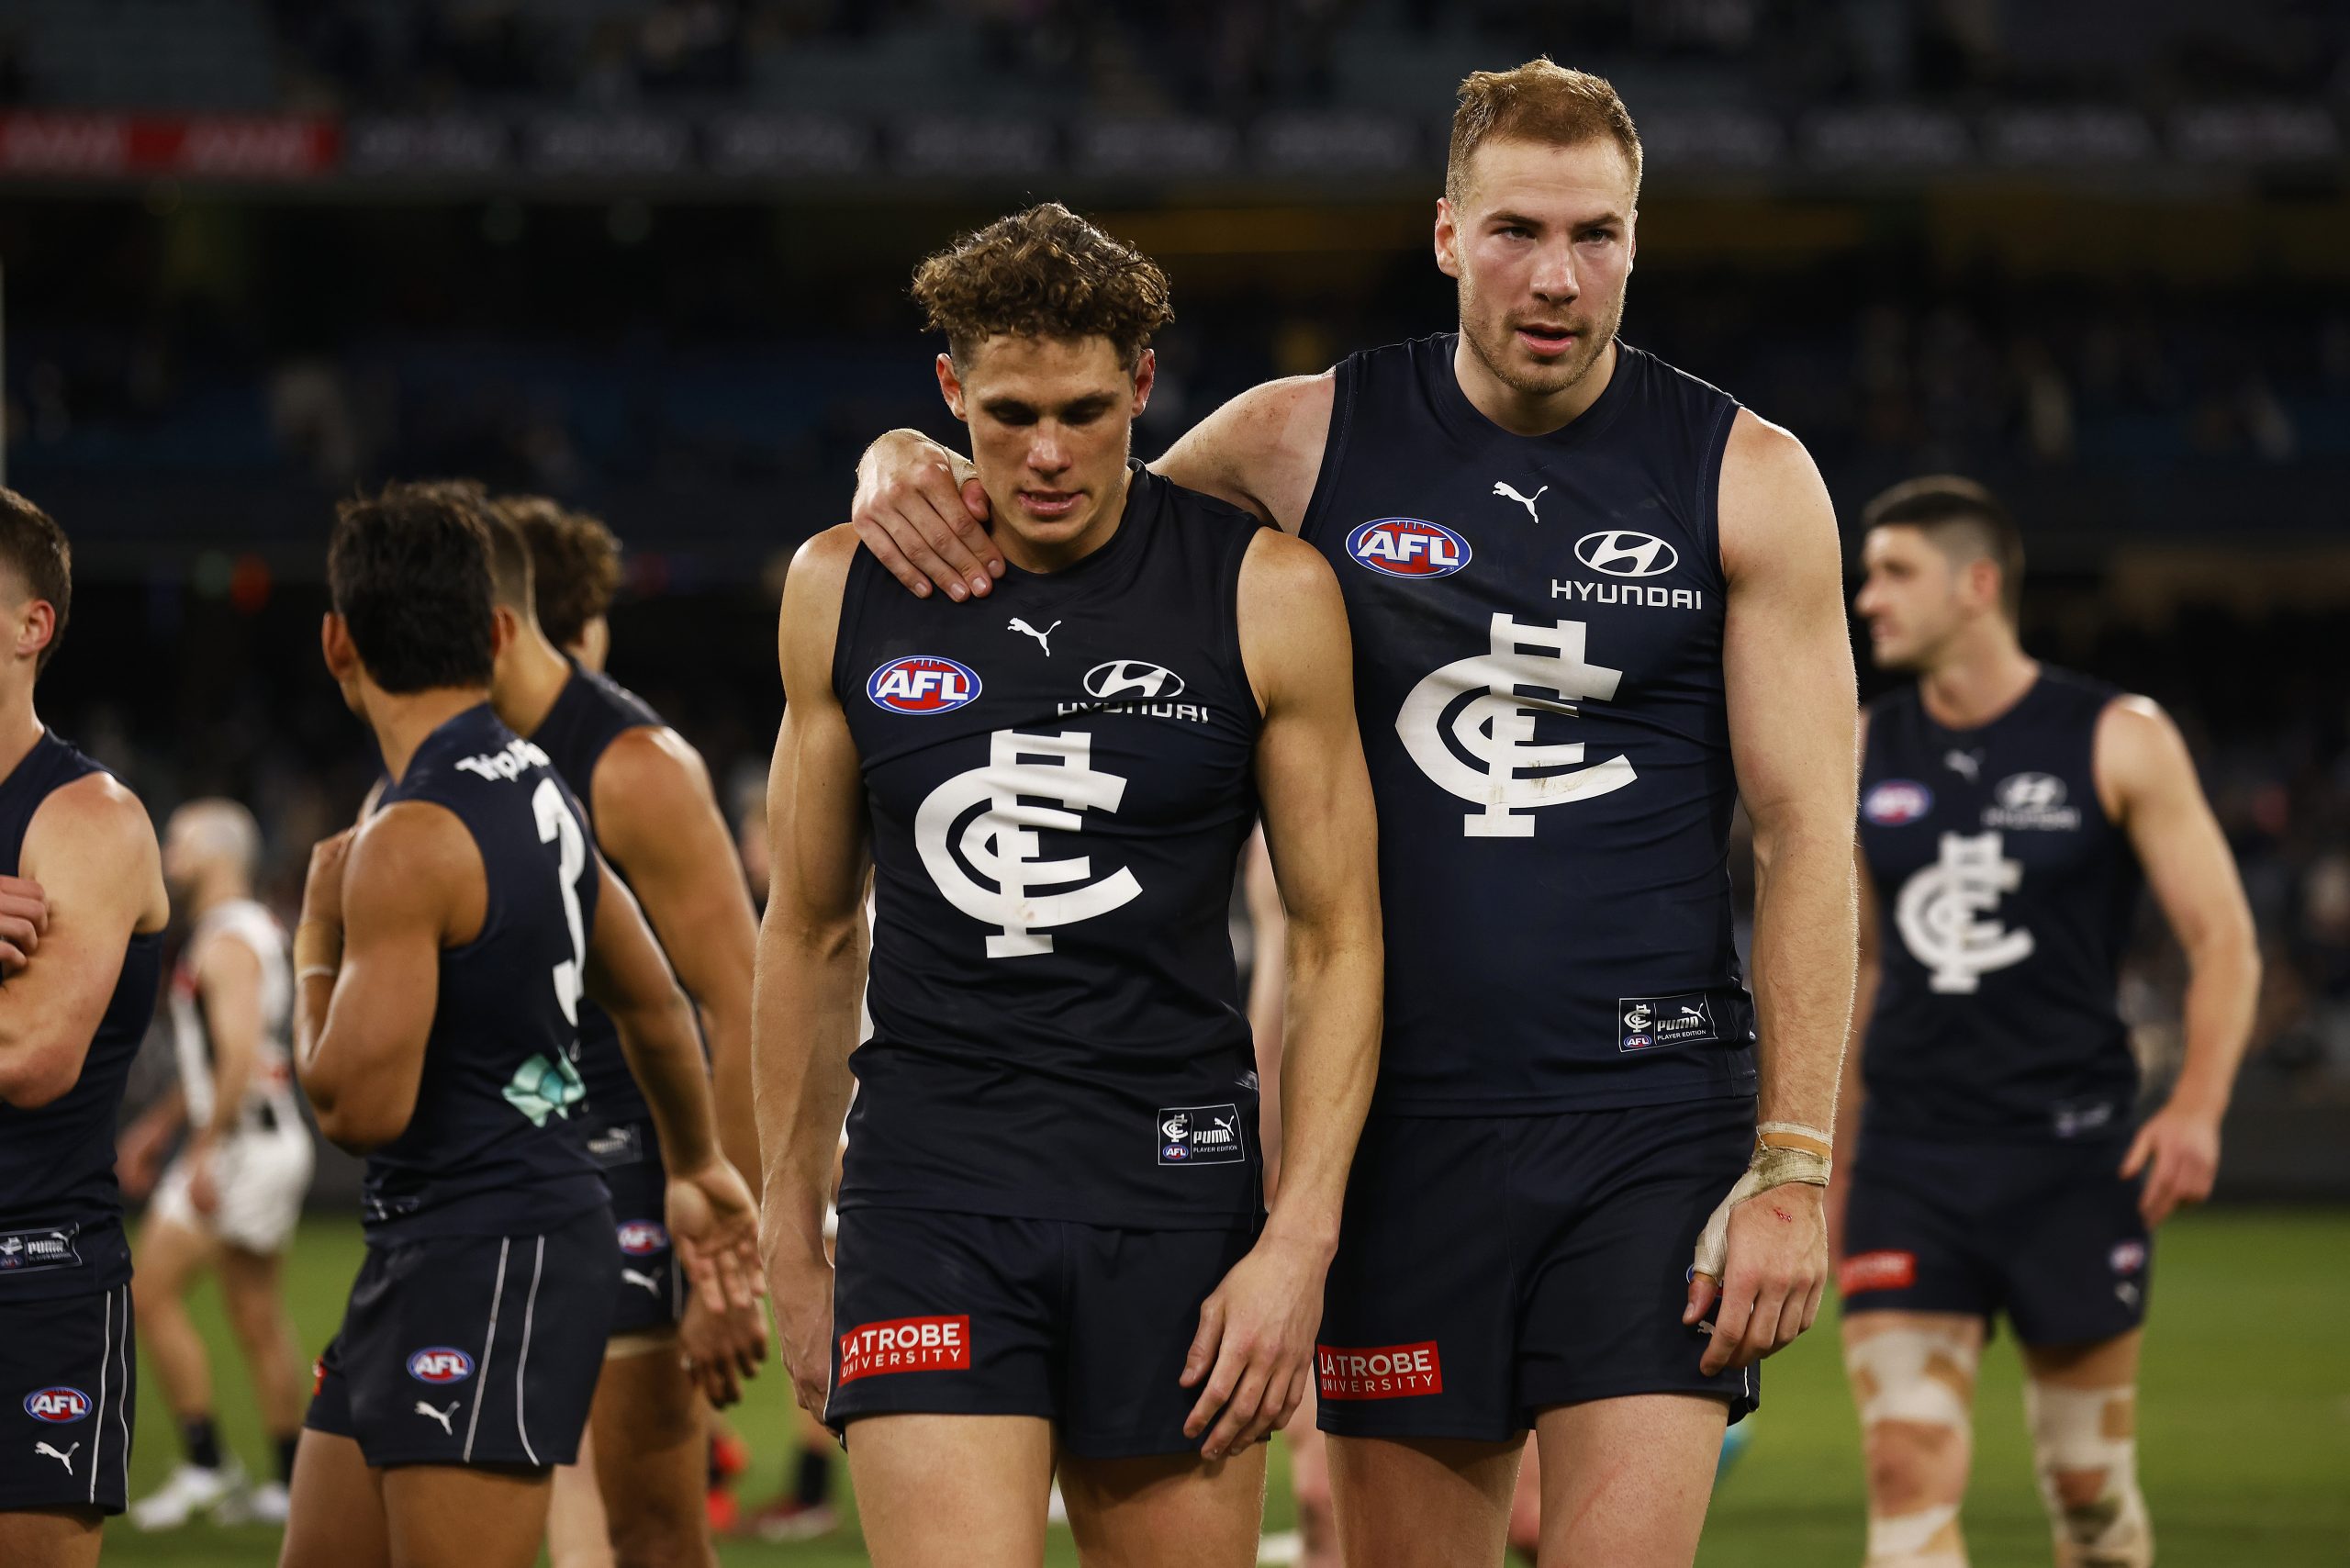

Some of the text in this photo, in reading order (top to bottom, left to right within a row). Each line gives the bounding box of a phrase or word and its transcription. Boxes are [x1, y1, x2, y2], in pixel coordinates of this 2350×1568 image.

[1357, 531, 1459, 567] AFL
[1550, 578, 1702, 610] HYUNDAI
[875, 669, 968, 701] AFL
[532, 777, 586, 1028] 3
[1657, 1015, 1699, 1032] PUMA
[1627, 1037, 1650, 1046] AFL
[1657, 1029, 1707, 1041] PLAYER EDITION
[1193, 1129, 1230, 1144] PUMA
[1166, 1148, 1186, 1157] AFL
[415, 1354, 468, 1376] AFL
[842, 1348, 961, 1378] UNIVERSITY
[1322, 1373, 1433, 1393] UNIVERSITY
[31, 1394, 86, 1415] AFL
